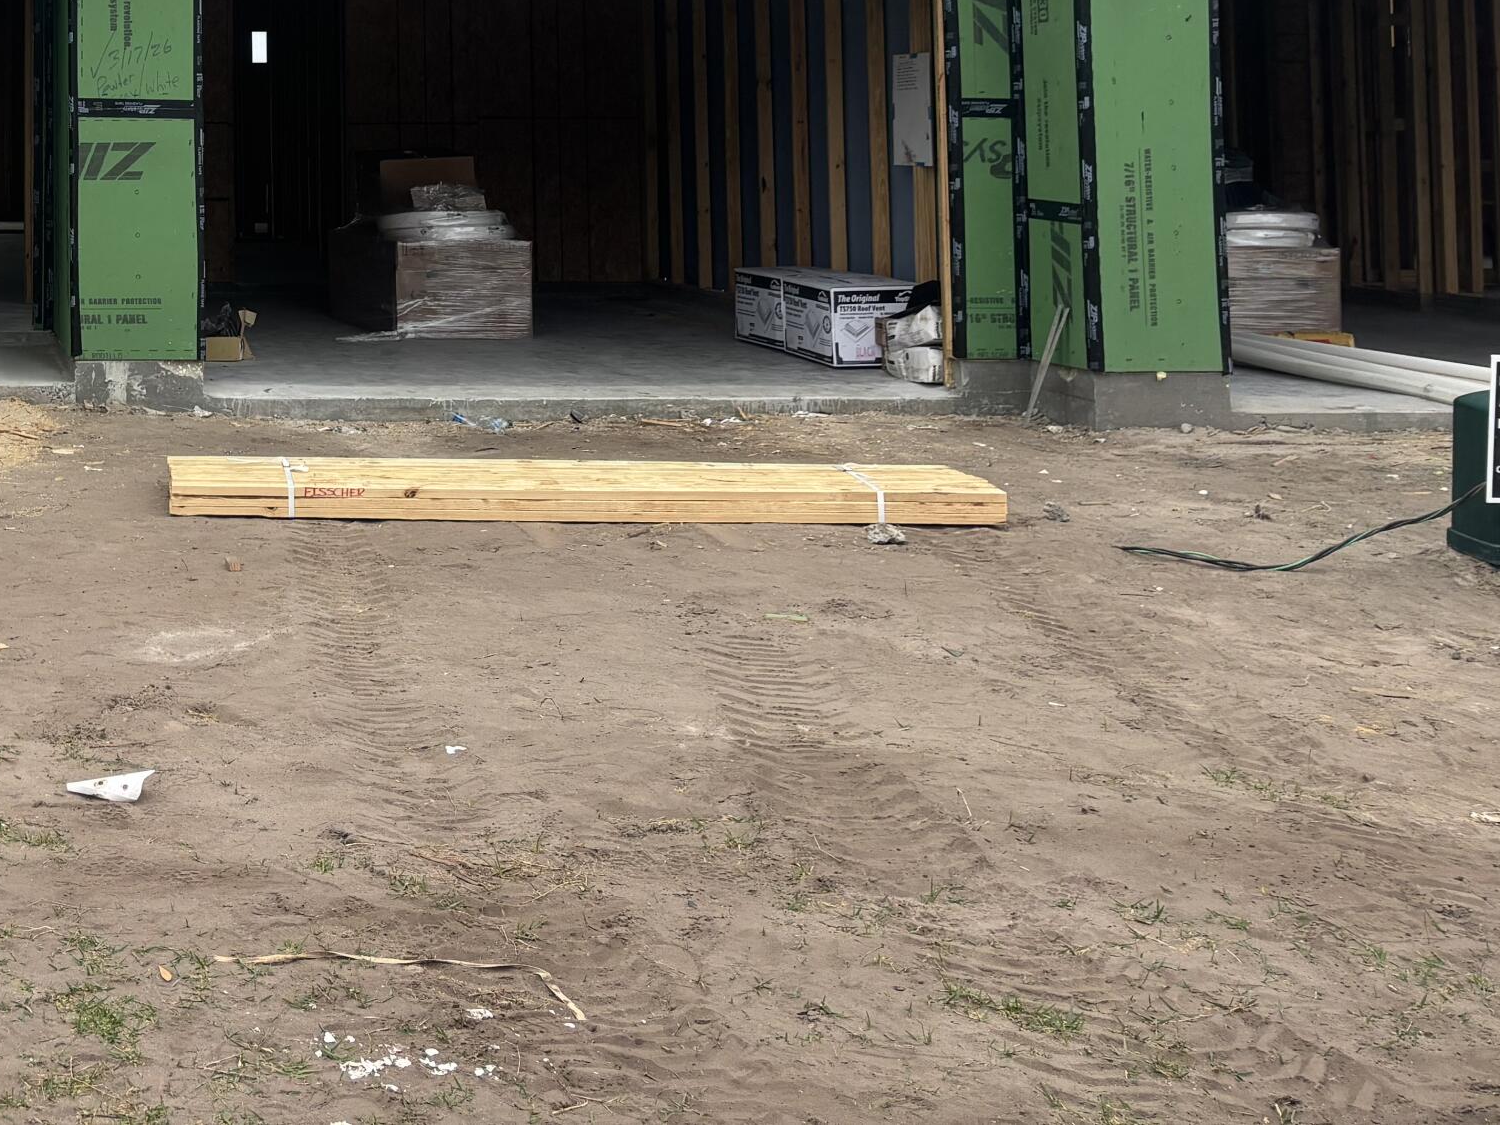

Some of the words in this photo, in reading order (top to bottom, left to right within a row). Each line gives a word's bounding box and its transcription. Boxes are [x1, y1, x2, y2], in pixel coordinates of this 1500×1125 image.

[1125, 196, 1138, 264] STRUCTURAL
[1128, 277, 1140, 312] PANEL
[116, 314, 148, 325] PANEL
